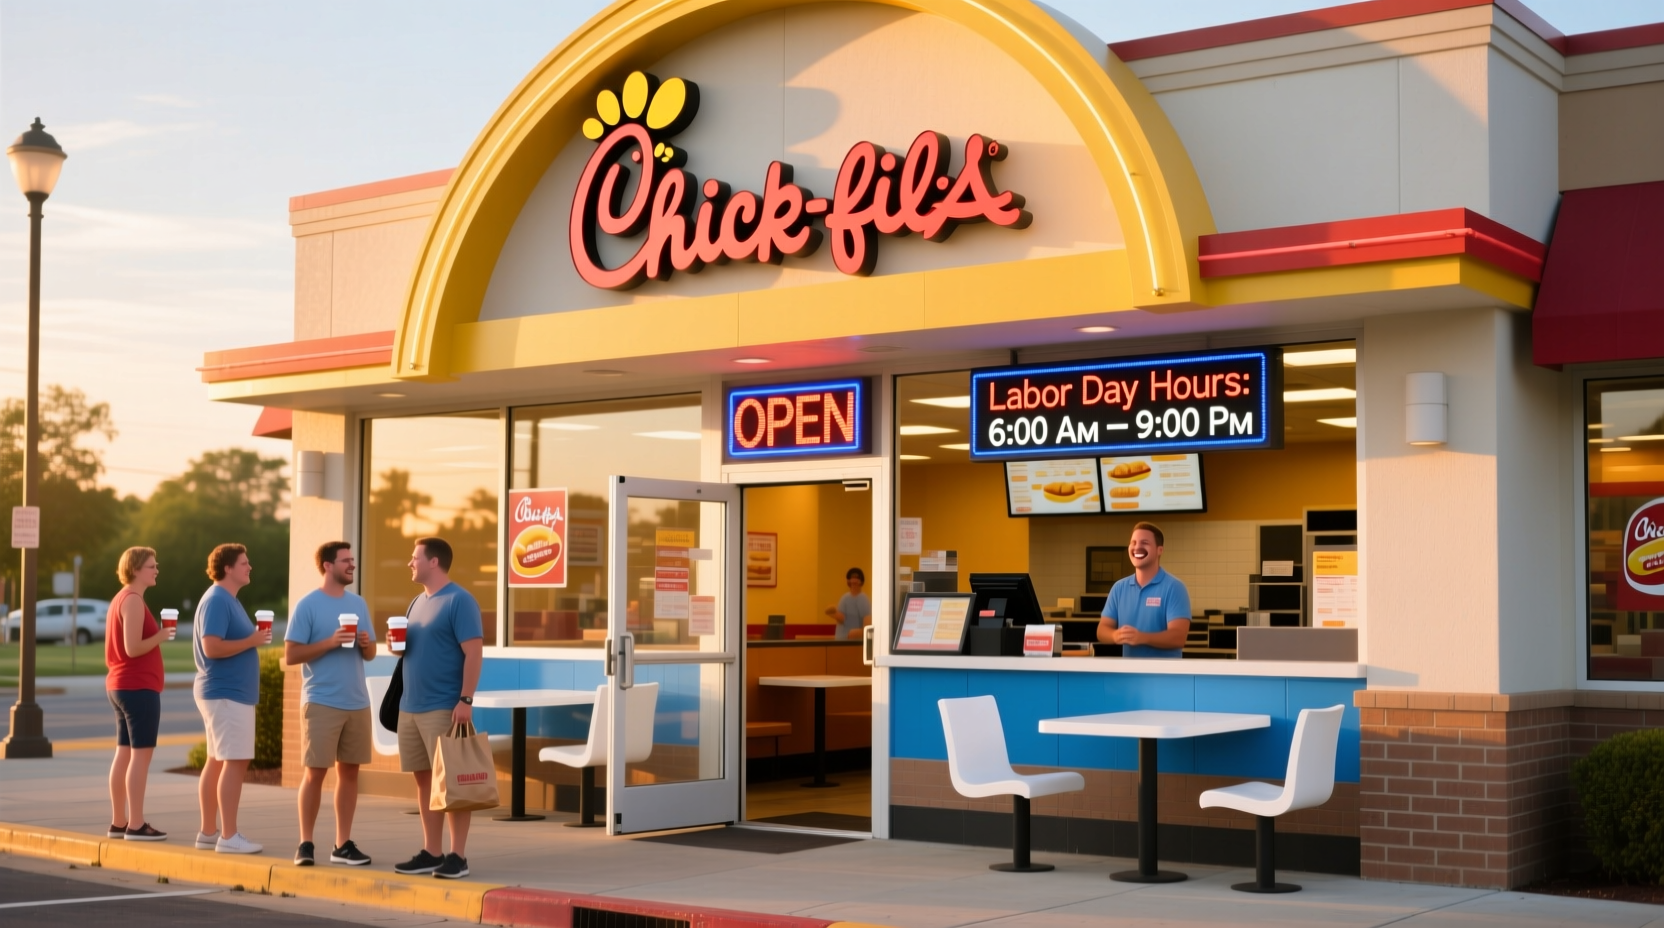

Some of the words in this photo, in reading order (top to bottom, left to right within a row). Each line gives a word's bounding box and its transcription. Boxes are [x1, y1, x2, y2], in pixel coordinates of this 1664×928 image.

[989, 378, 1073, 411] Labor
[1082, 375, 1139, 411] Day
[1150, 369, 1250, 401] Hours:
[734, 391, 854, 448] OPEN
[988, 415, 1048, 447] 6:00
[1135, 407, 1200, 439] 9:00
